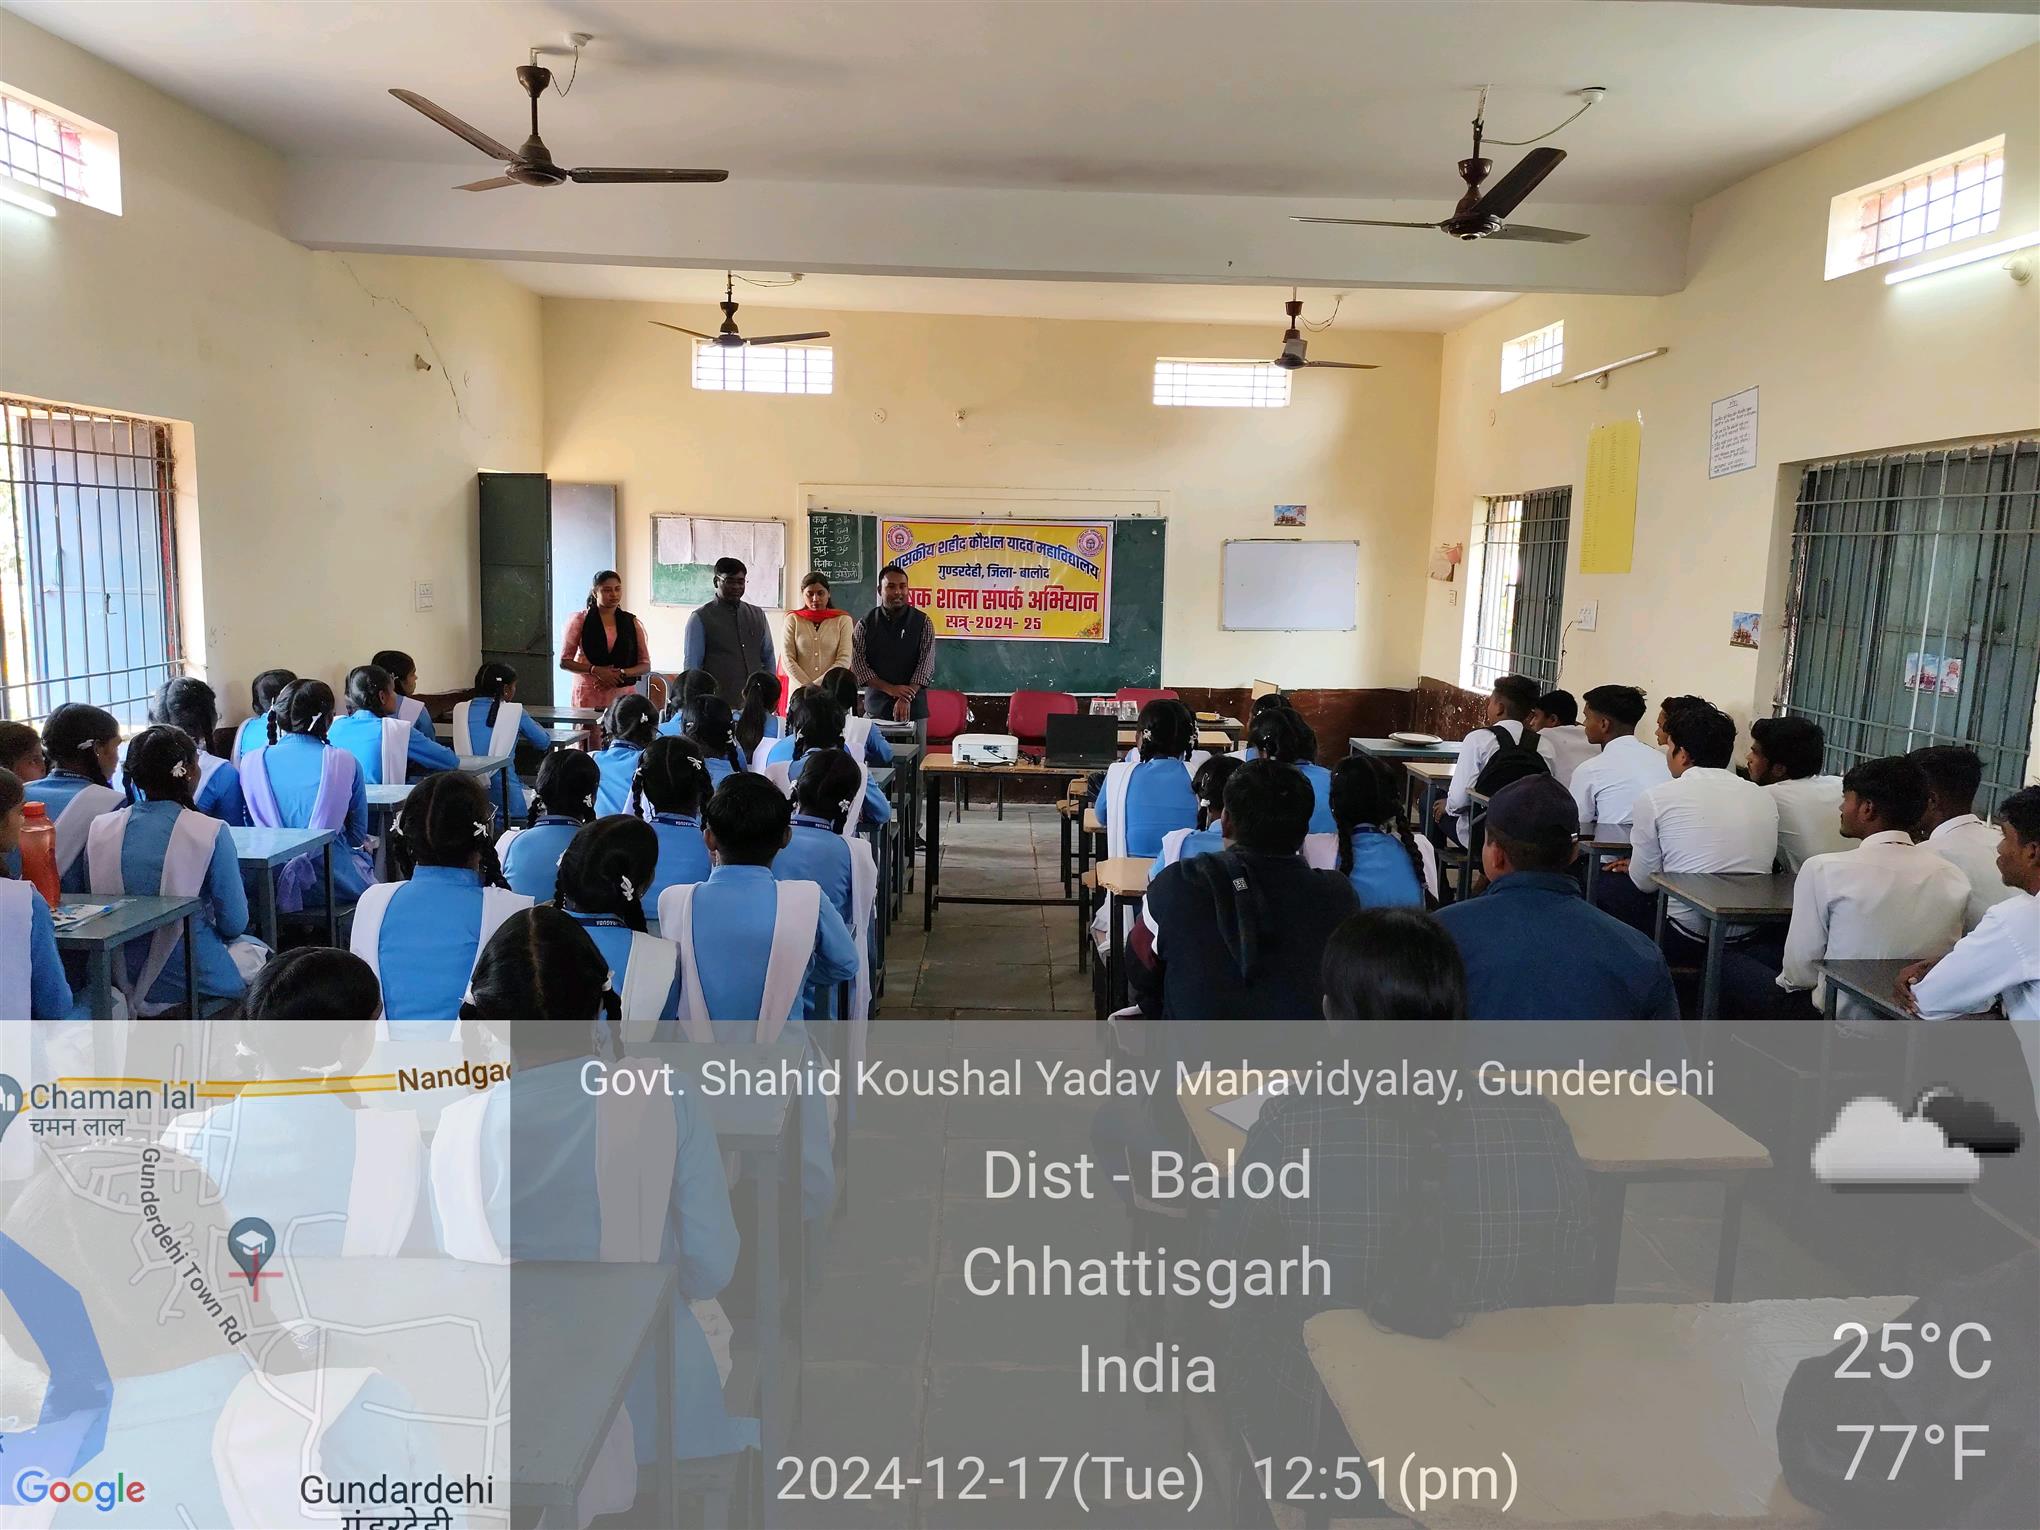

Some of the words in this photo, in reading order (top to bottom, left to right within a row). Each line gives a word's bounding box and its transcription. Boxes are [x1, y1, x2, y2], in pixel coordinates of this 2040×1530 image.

[938, 534, 968, 554] शहीद
[968, 532, 1005, 549] कौशल
[1006, 537, 1034, 552] यादव
[1035, 541, 1100, 580] महाविद्यालय
[938, 562, 985, 580] गुण्डरदेही,
[986, 563, 1017, 578] जिला-
[1019, 564, 1051, 579] बालोद
[936, 588, 979, 610] शाला
[981, 583, 1024, 611] संपर्क
[1028, 584, 1099, 612] अभियान
[1024, 617, 1041, 630] 25
